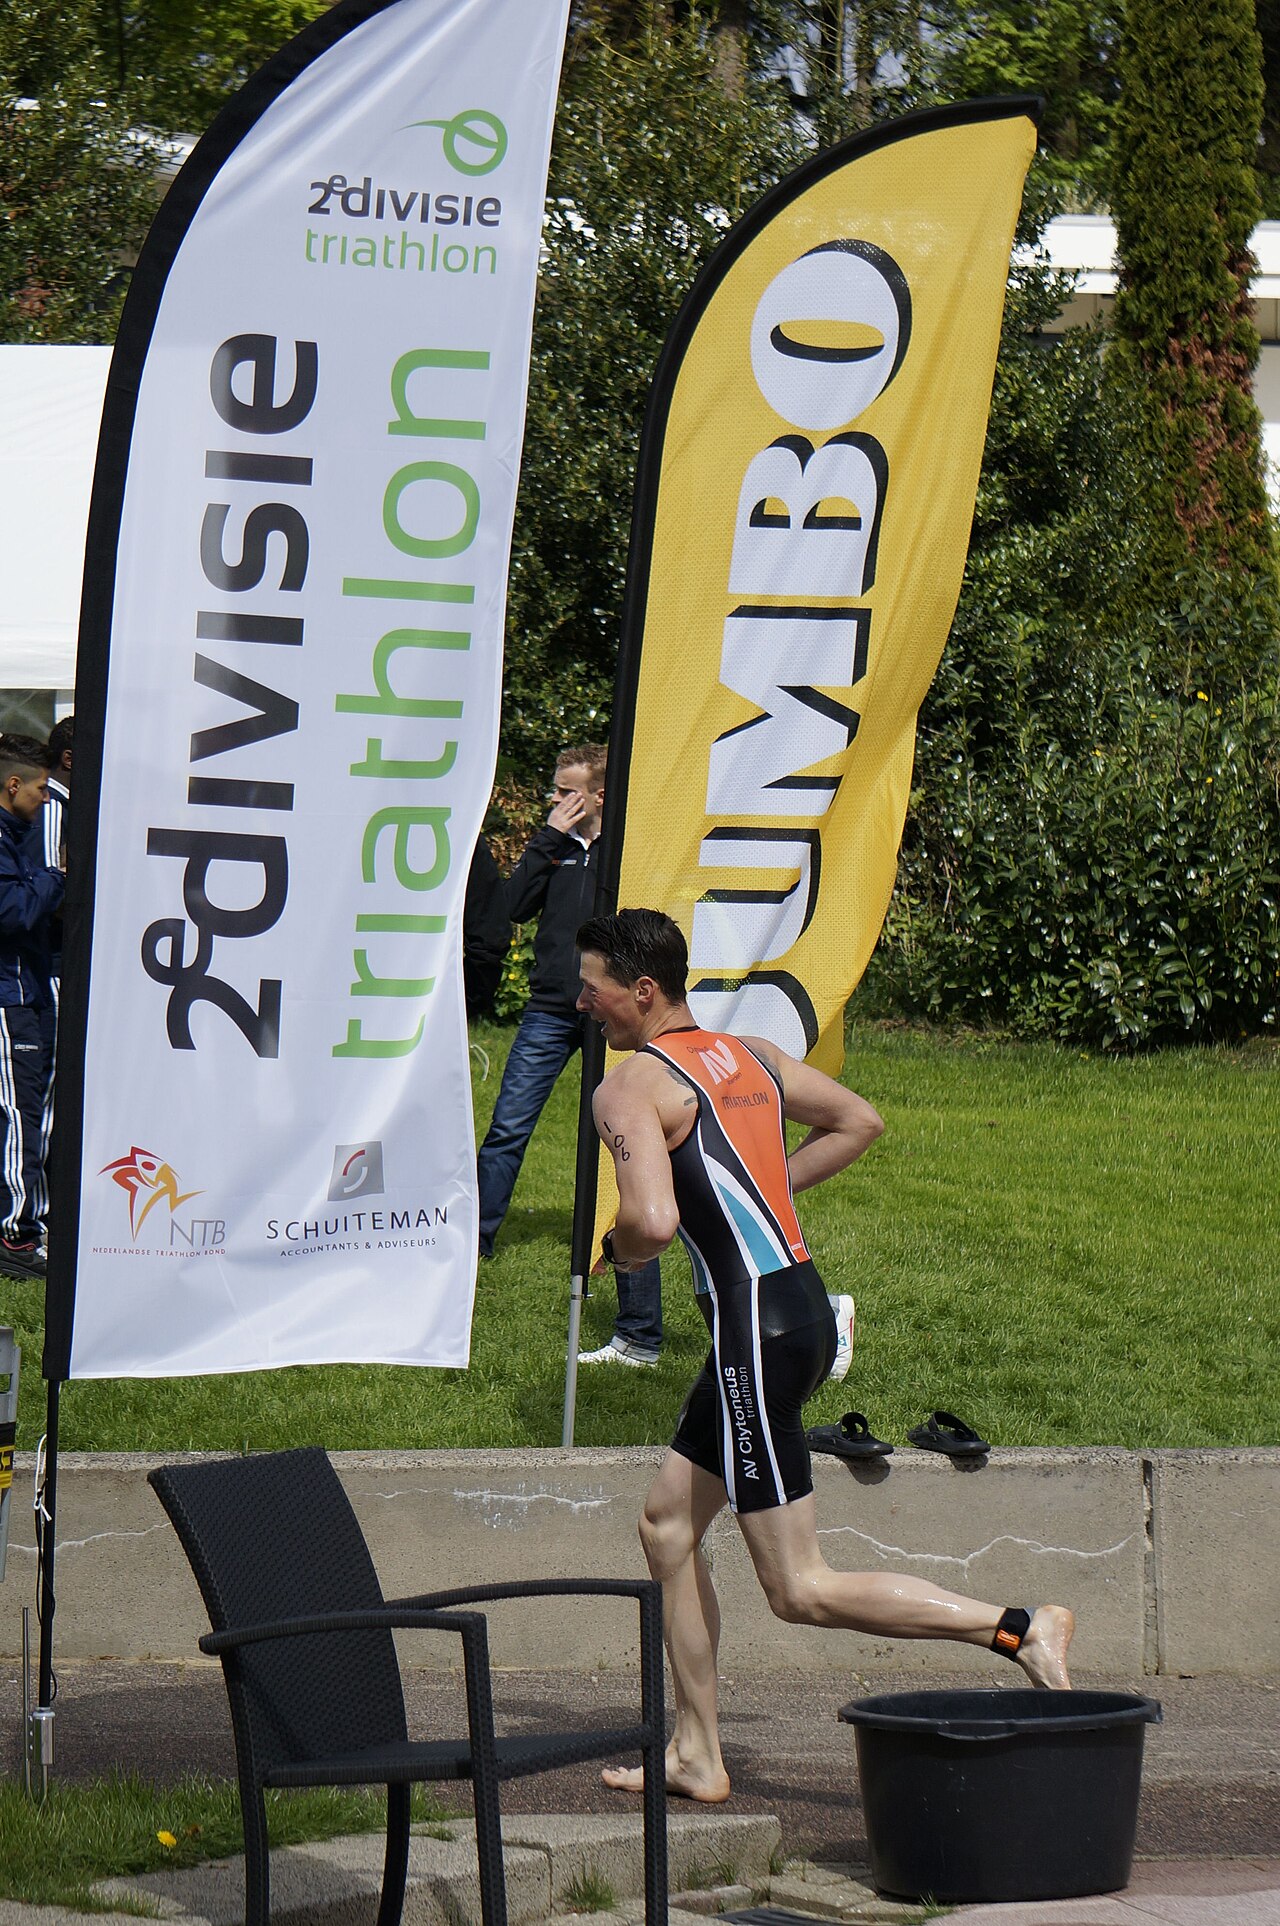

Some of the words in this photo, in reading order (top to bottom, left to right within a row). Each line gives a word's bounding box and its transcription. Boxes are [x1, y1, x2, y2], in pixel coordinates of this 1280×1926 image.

[305, 228, 497, 275] triathlon
[686, 238, 913, 1063] JUMBO
[332, 347, 491, 1060] triathlon
[721, 1091, 770, 1110] TRIATHLON
[169, 1217, 226, 1247] NTB
[266, 1206, 448, 1241] SCHUITEMAN
[92, 1247, 151, 1256] NEDERLANDSE
[155, 1249, 201, 1258] TRIATHLON
[204, 1248, 226, 1256] BOND
[280, 1242, 360, 1257] ACCOUNTANTS
[364, 1241, 372, 1250] &
[377, 1237, 437, 1249] ADVISEURS
[724, 1366, 753, 1454] Clytoneus
[738, 1366, 756, 1419] triathlon
[742, 1459, 760, 1480] AV
